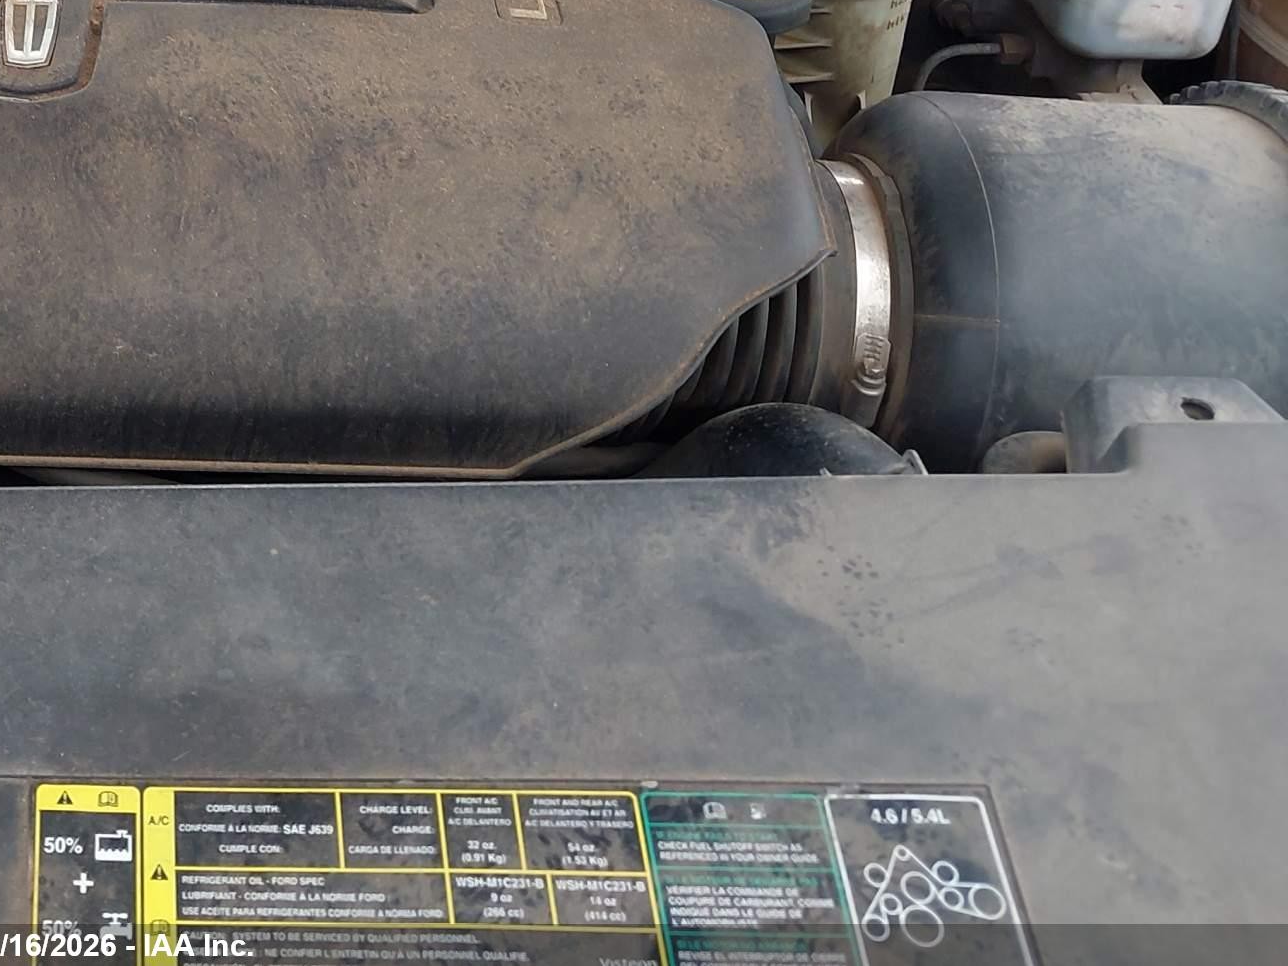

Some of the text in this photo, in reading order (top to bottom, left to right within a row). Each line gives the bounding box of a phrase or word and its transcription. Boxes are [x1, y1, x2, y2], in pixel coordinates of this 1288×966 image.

[206, 804, 253, 814] COMPLIES
[359, 805, 433, 814] CHARGE LEVEL:
[147, 815, 171, 826] A/C
[870, 808, 898, 825] 4.6
[910, 808, 952, 825] 5.4L
[235, 825, 247, 833] LA
[283, 823, 306, 835] SAE
[308, 824, 334, 835] J639
[392, 825, 435, 834] CHARGE:
[43, 836, 83, 854] 50%
[218, 844, 257, 853] CUMPLE
[349, 845, 379, 854] CARGA
[380, 845, 392, 854] DE
[181, 876, 247, 886] REFRIGERANT
[248, 876, 264, 886] OIL
[271, 877, 298, 886] FORD
[299, 877, 325, 887] SPEC
[181, 891, 236, 901] LUBRIFIANT
[232, 907, 255, 916] PARA
[41, 920, 83, 939] 50%
